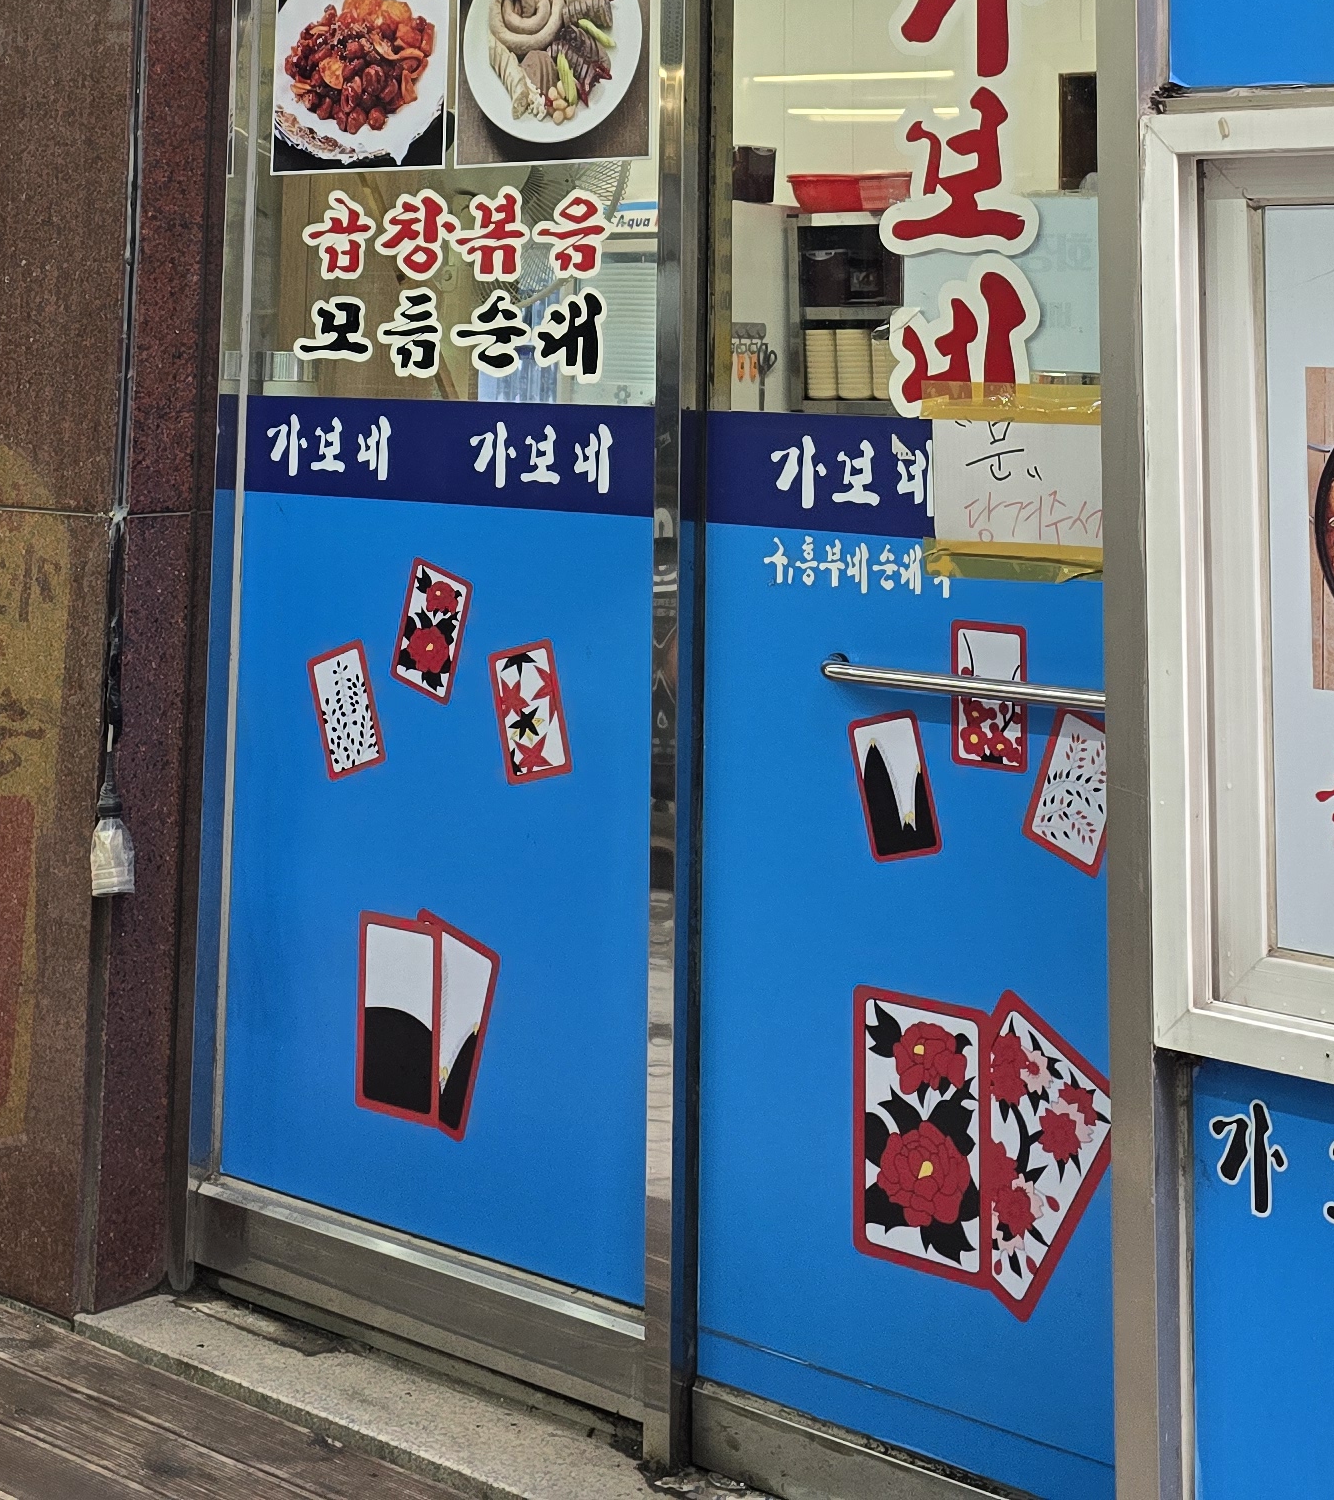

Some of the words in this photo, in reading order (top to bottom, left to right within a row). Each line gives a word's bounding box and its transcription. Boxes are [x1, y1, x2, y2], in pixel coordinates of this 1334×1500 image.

[310, 198, 607, 275] 곱창볶음
[299, 293, 604, 377] 모듬순대
[266, 414, 392, 482] 가보네
[469, 422, 614, 494] 가보네
[771, 435, 934, 518] 가보네
